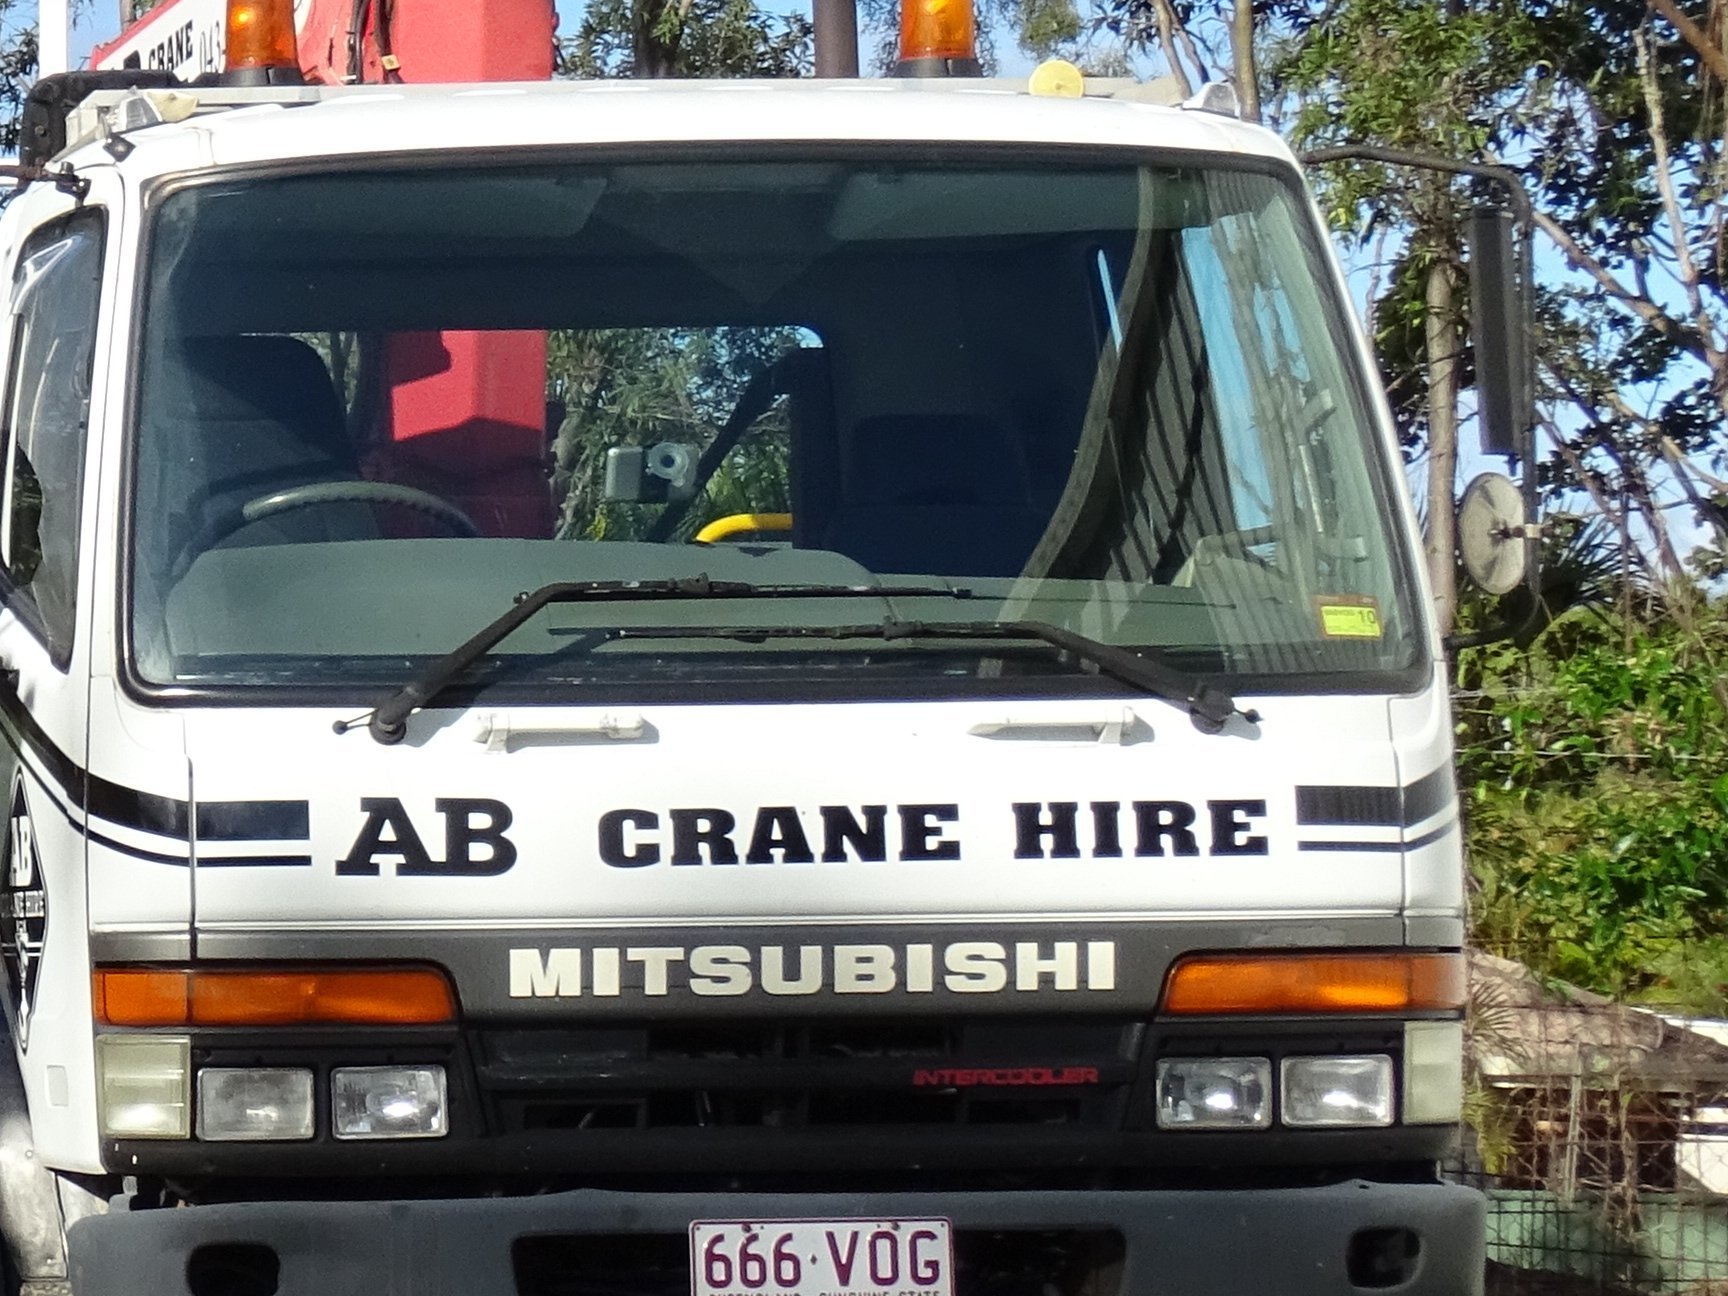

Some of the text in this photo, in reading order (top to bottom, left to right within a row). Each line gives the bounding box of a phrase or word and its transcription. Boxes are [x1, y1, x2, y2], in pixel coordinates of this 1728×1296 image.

[1358, 610, 1376, 624] 10
[9, 816, 32, 886] AB
[335, 797, 1269, 876] AB CRANE HIRE
[509, 941, 1115, 997] MITSUBISHI
[913, 1066, 1099, 1086] INTERCOOLER
[704, 1230, 940, 1289] 666 VOG
